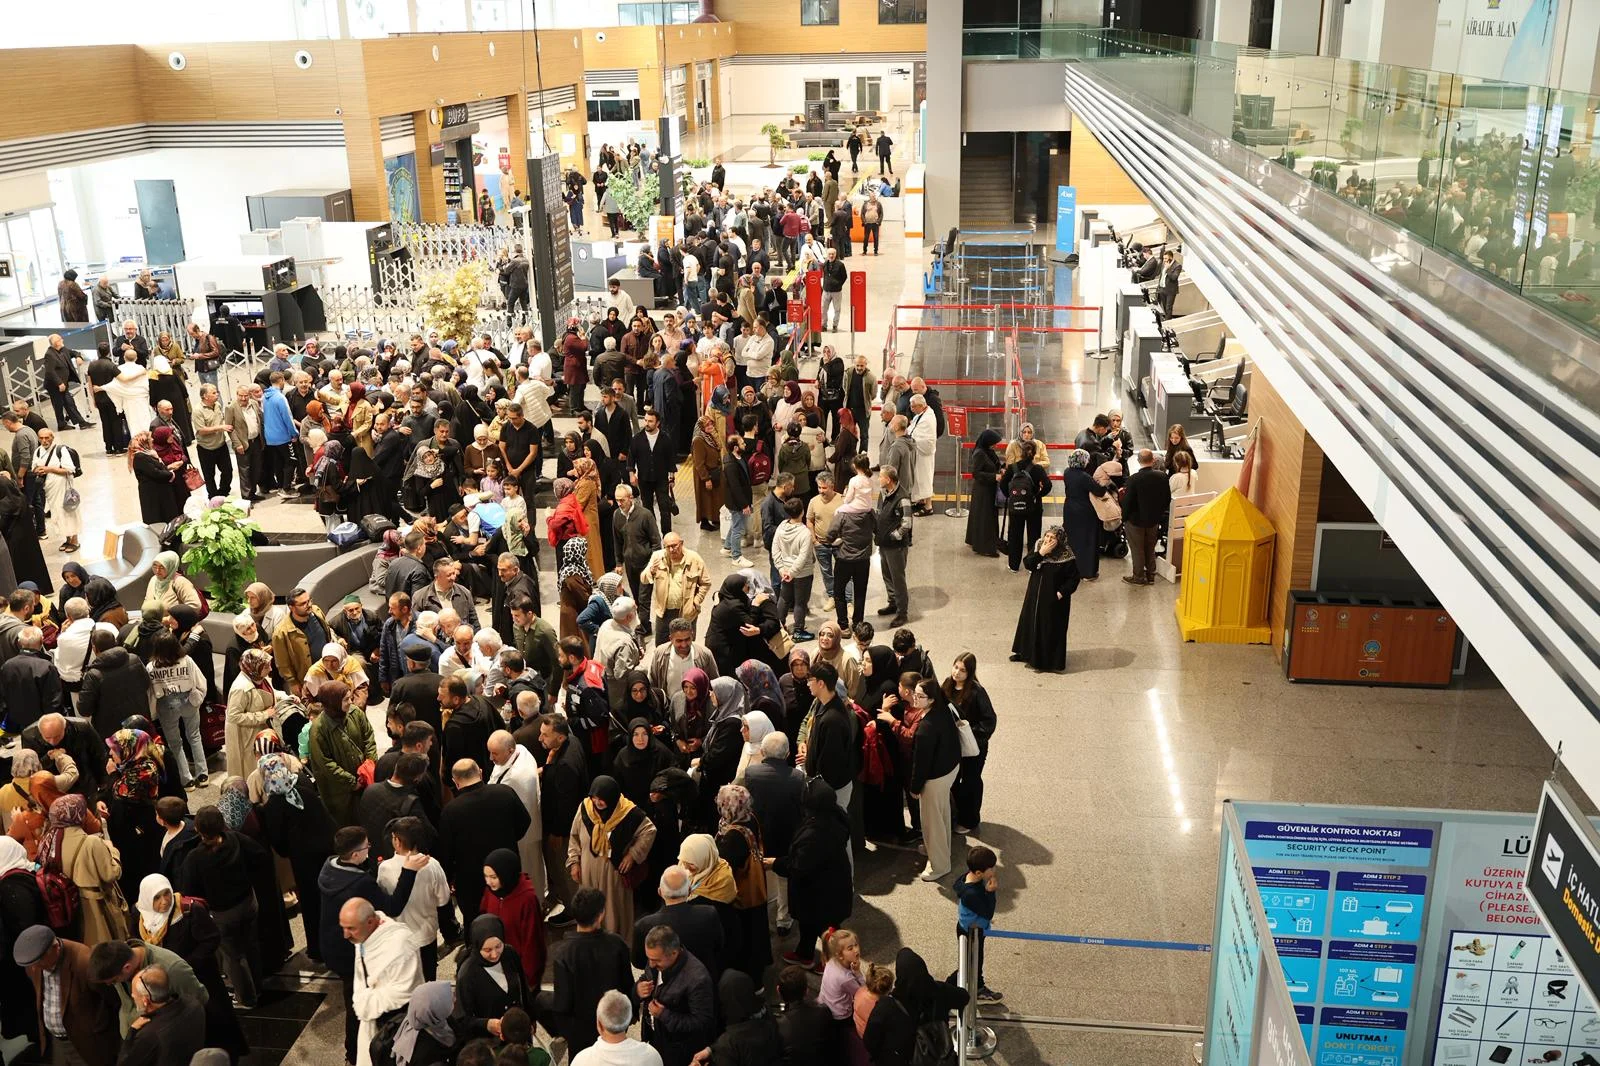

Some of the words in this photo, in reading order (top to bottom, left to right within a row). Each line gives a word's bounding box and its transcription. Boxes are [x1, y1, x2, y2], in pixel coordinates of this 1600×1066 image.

[149, 668, 174, 680] SIMPLE
[176, 667, 190, 676] LIFE
[1277, 824, 1319, 833] GÜVENLİK
[1320, 827, 1361, 836] KONTROL
[1362, 829, 1401, 837] NOKTASI
[1287, 844, 1328, 852] SECURITY
[1360, 847, 1387, 855] POINT
[1465, 880, 1513, 889] KUTUYA
[1486, 891, 1528, 901] CİHAZI
[1577, 882, 1600, 930] HATL
[1563, 887, 1596, 944] Domestic
[1336, 1032, 1382, 1043] UNUTMA
